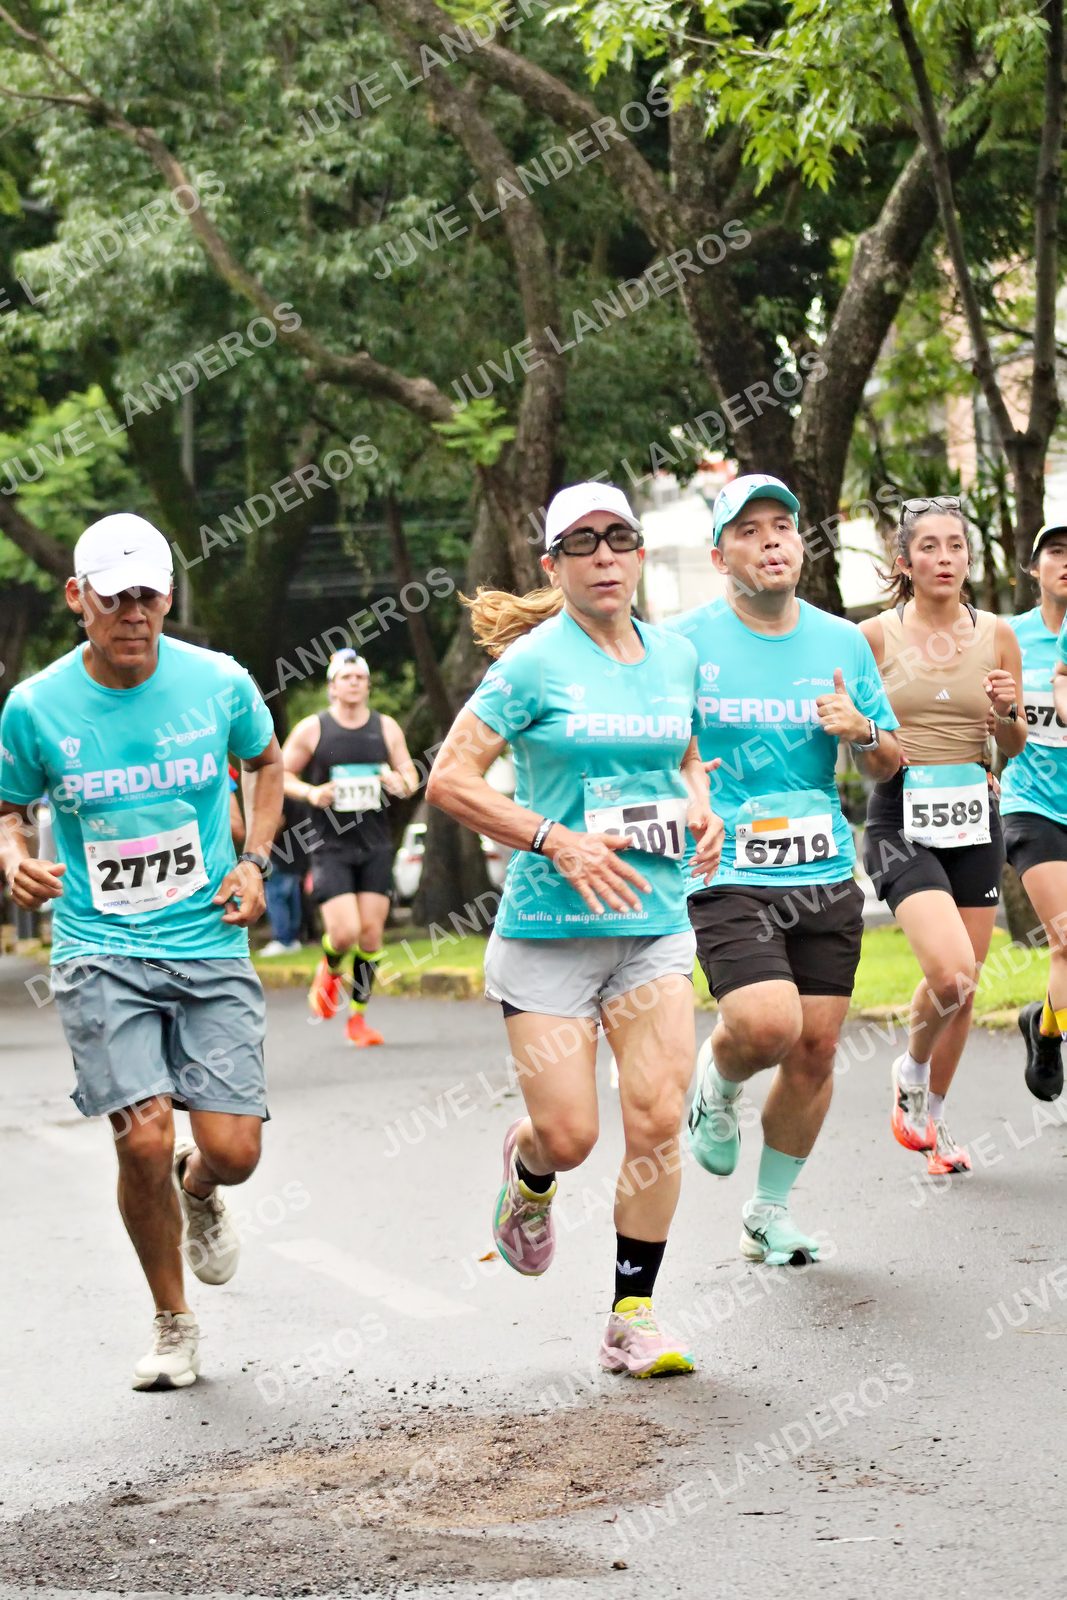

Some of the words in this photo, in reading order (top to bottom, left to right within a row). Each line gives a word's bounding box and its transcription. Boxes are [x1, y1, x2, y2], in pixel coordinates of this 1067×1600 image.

[176, 725, 216, 743] BROOKS
[63, 752, 218, 800] PERDURA
[911, 800, 982, 828] 5589
[745, 833, 830, 865] 6719
[97, 842, 196, 892] 2775
[518, 910, 552, 921] familia
[556, 914, 562, 924] y
[565, 911, 600, 924] amigos
